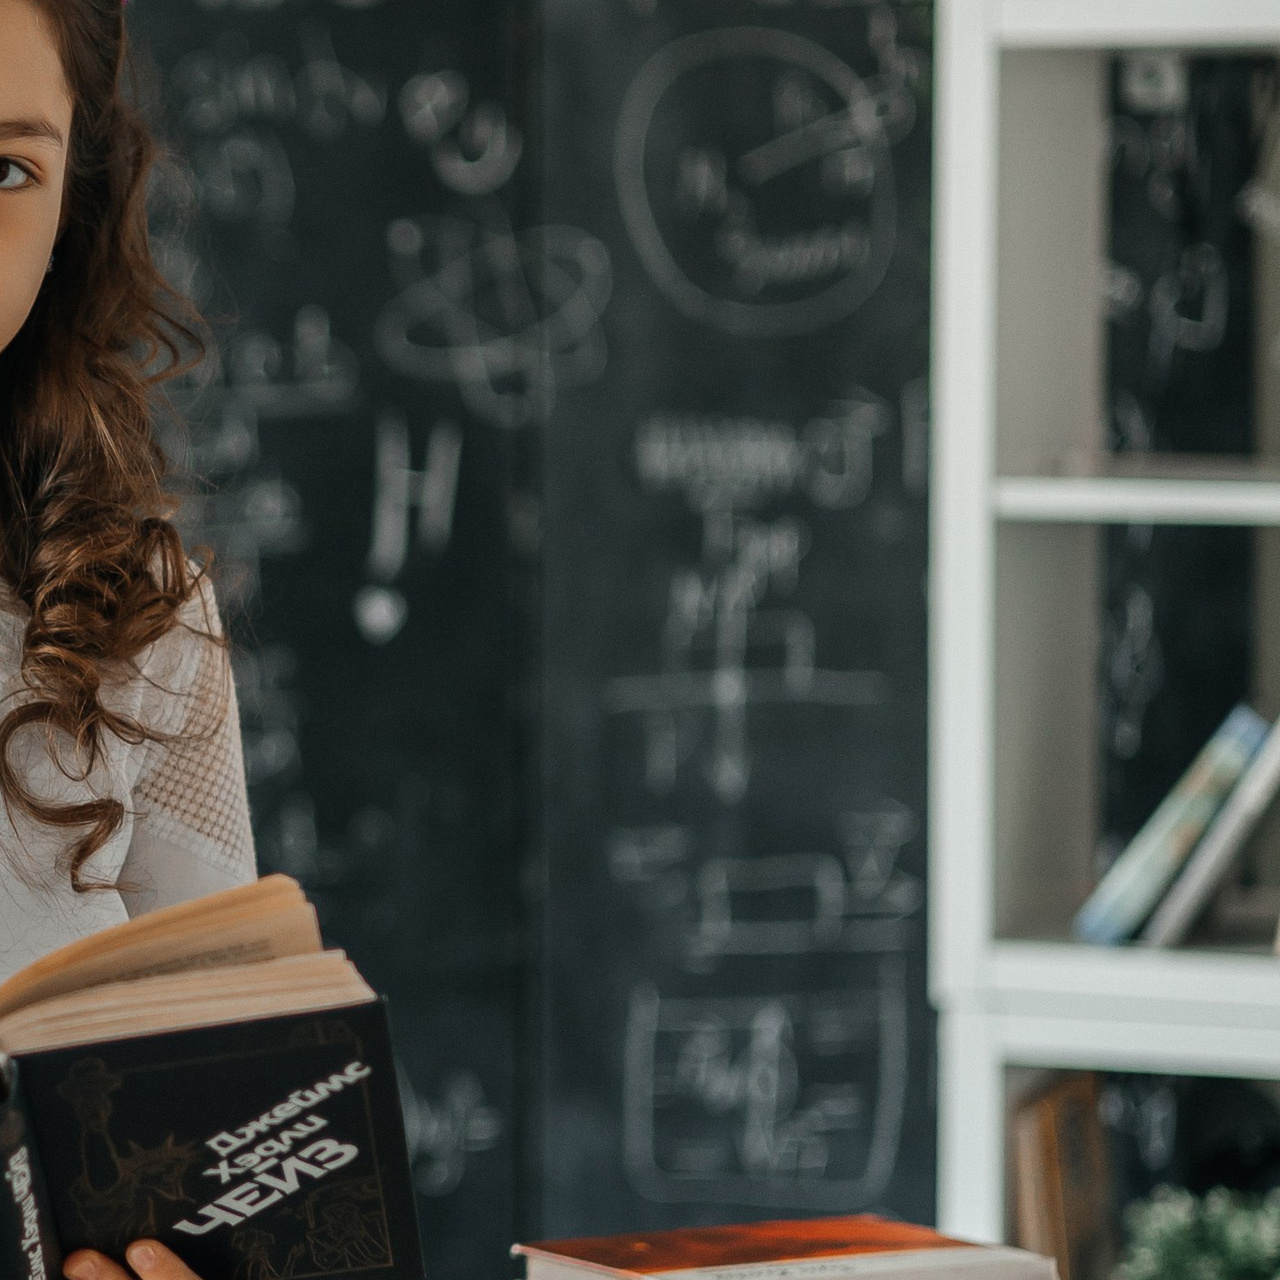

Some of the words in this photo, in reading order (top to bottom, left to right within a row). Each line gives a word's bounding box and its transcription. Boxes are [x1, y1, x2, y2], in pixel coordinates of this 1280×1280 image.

[202, 1114, 329, 1184] Хэдли
[205, 1060, 373, 1157] Джеймс
[172, 1137, 359, 1237] ЧЕЙЗ
